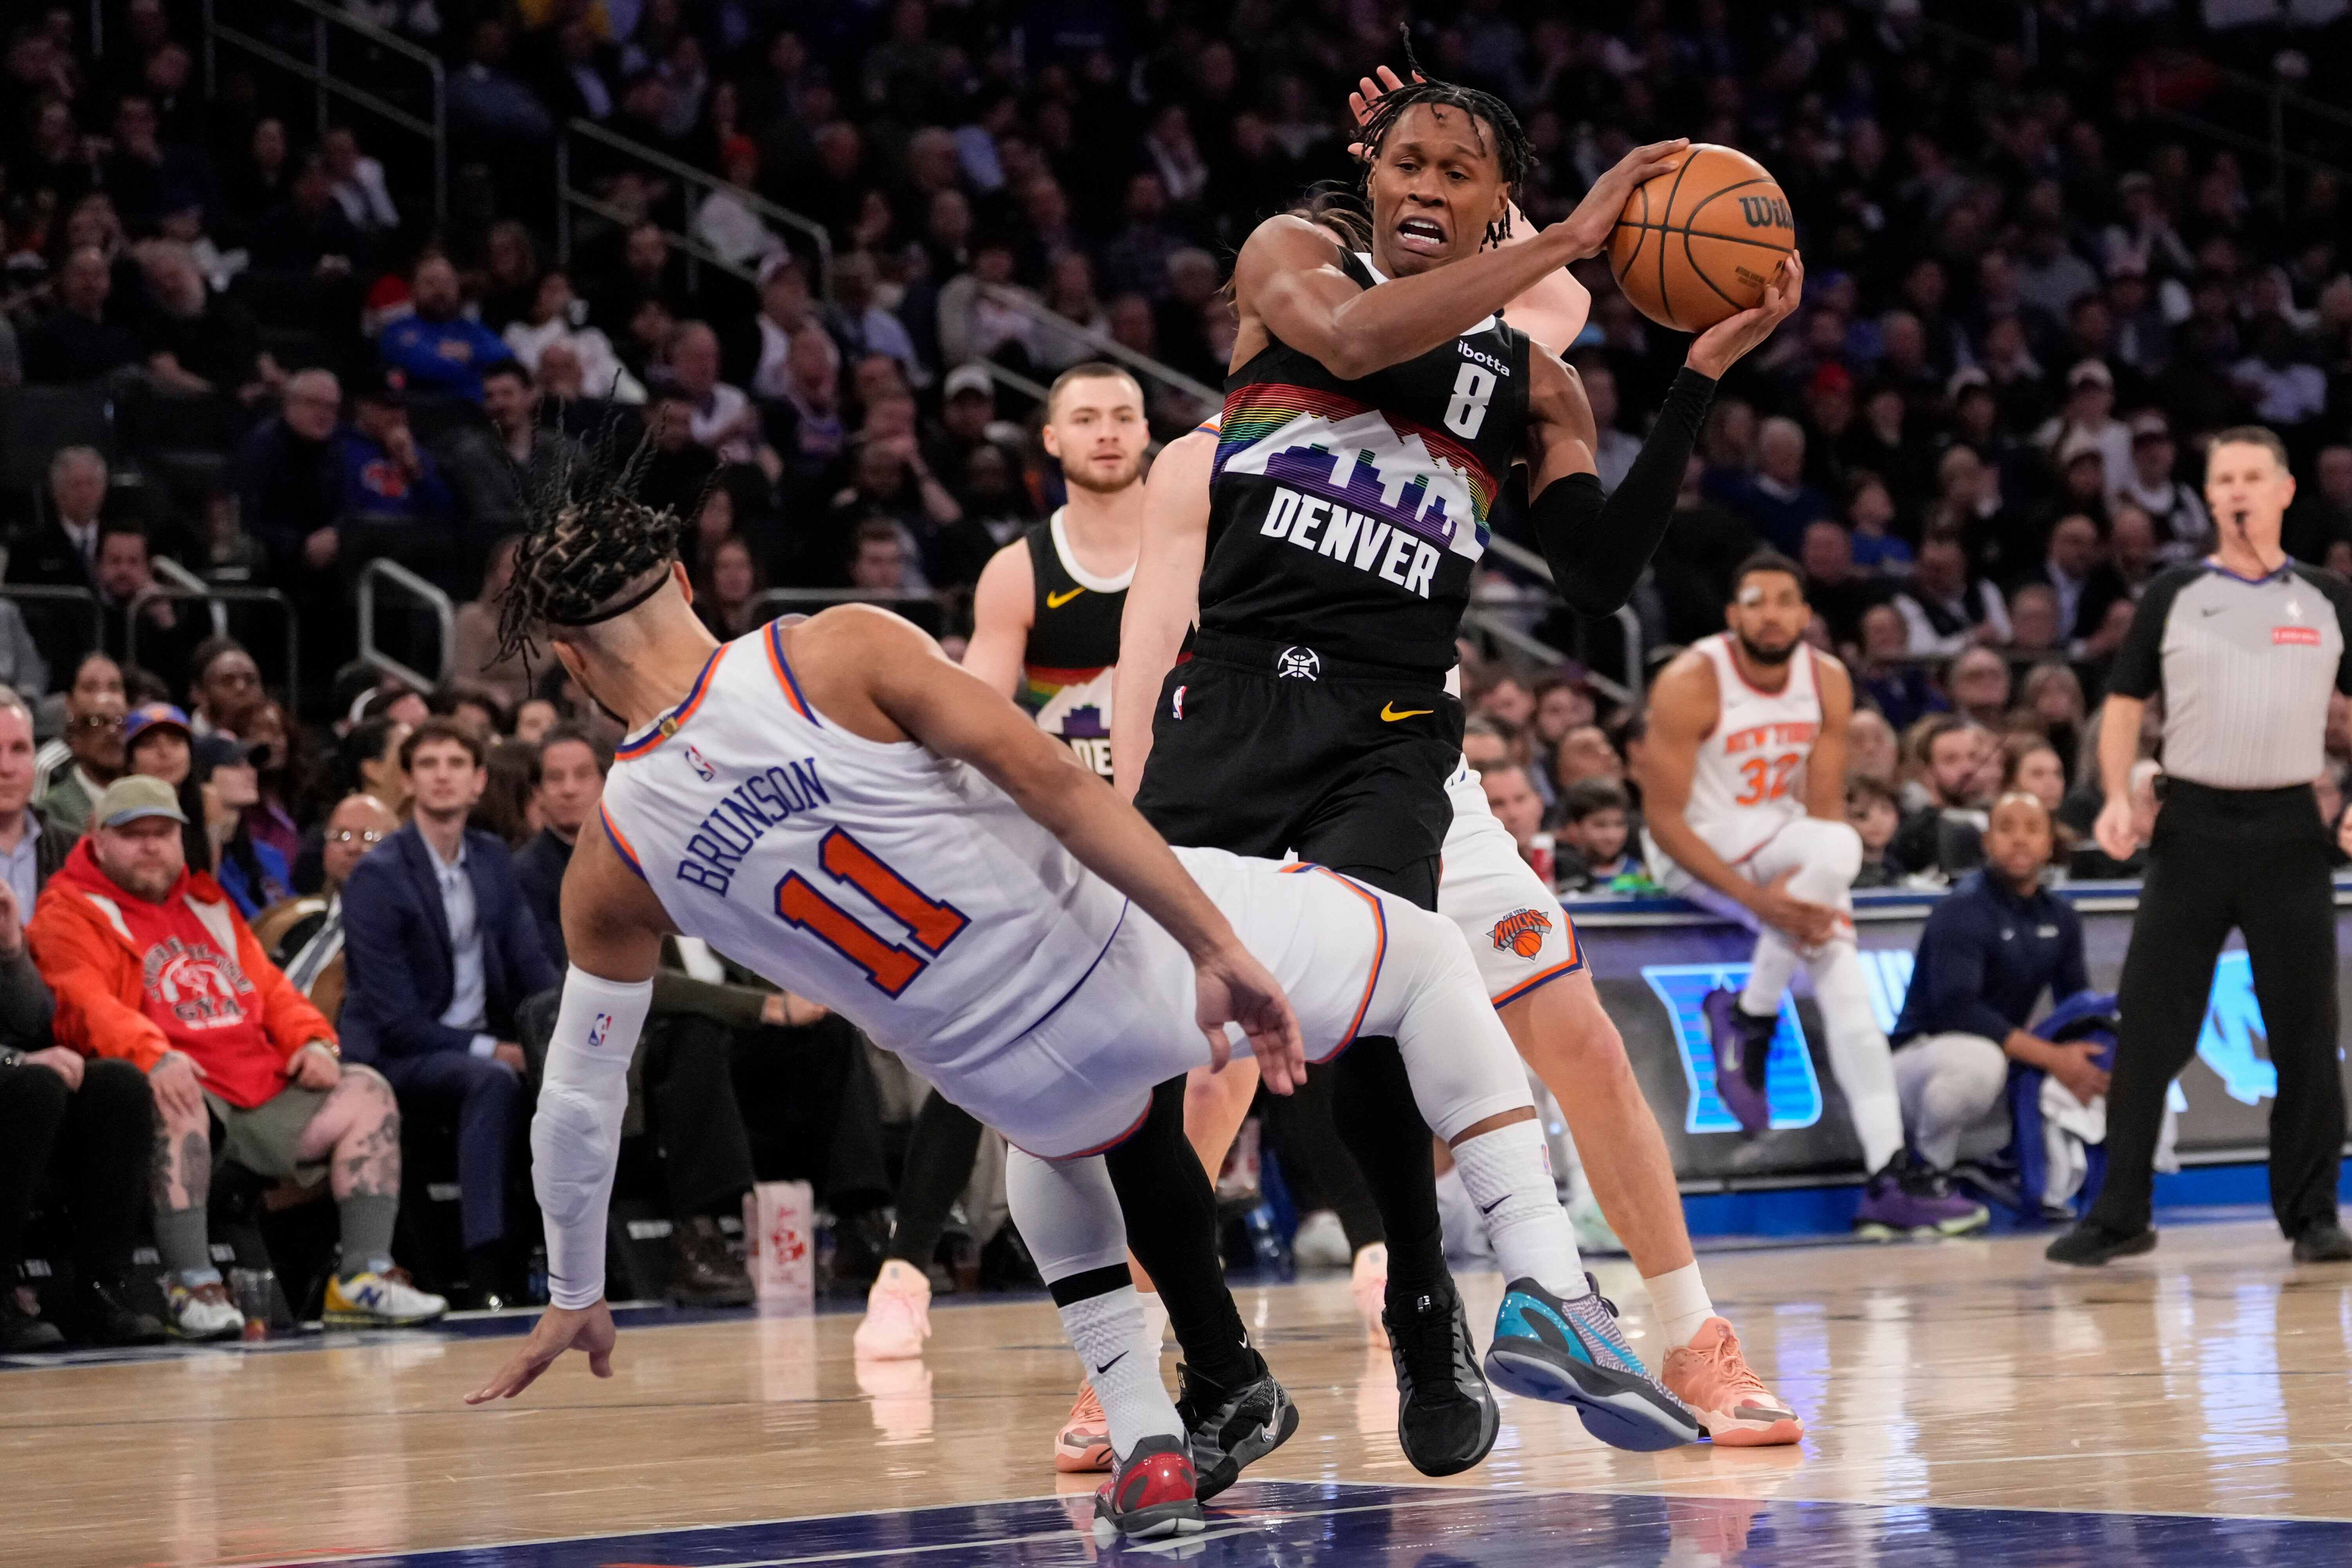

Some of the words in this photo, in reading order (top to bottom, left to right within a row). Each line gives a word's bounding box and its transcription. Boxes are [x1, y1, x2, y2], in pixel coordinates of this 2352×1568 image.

[1457, 340, 1510, 377] ibotta
[1443, 362, 1497, 439] 8
[1260, 487, 1441, 600] DENVER
[1736, 752, 1800, 806] 32
[676, 757, 830, 898] BRUNSON
[773, 824, 972, 1000] 11
[1494, 909, 1553, 949] KNICKS
[1503, 912, 1513, 921] NEW
